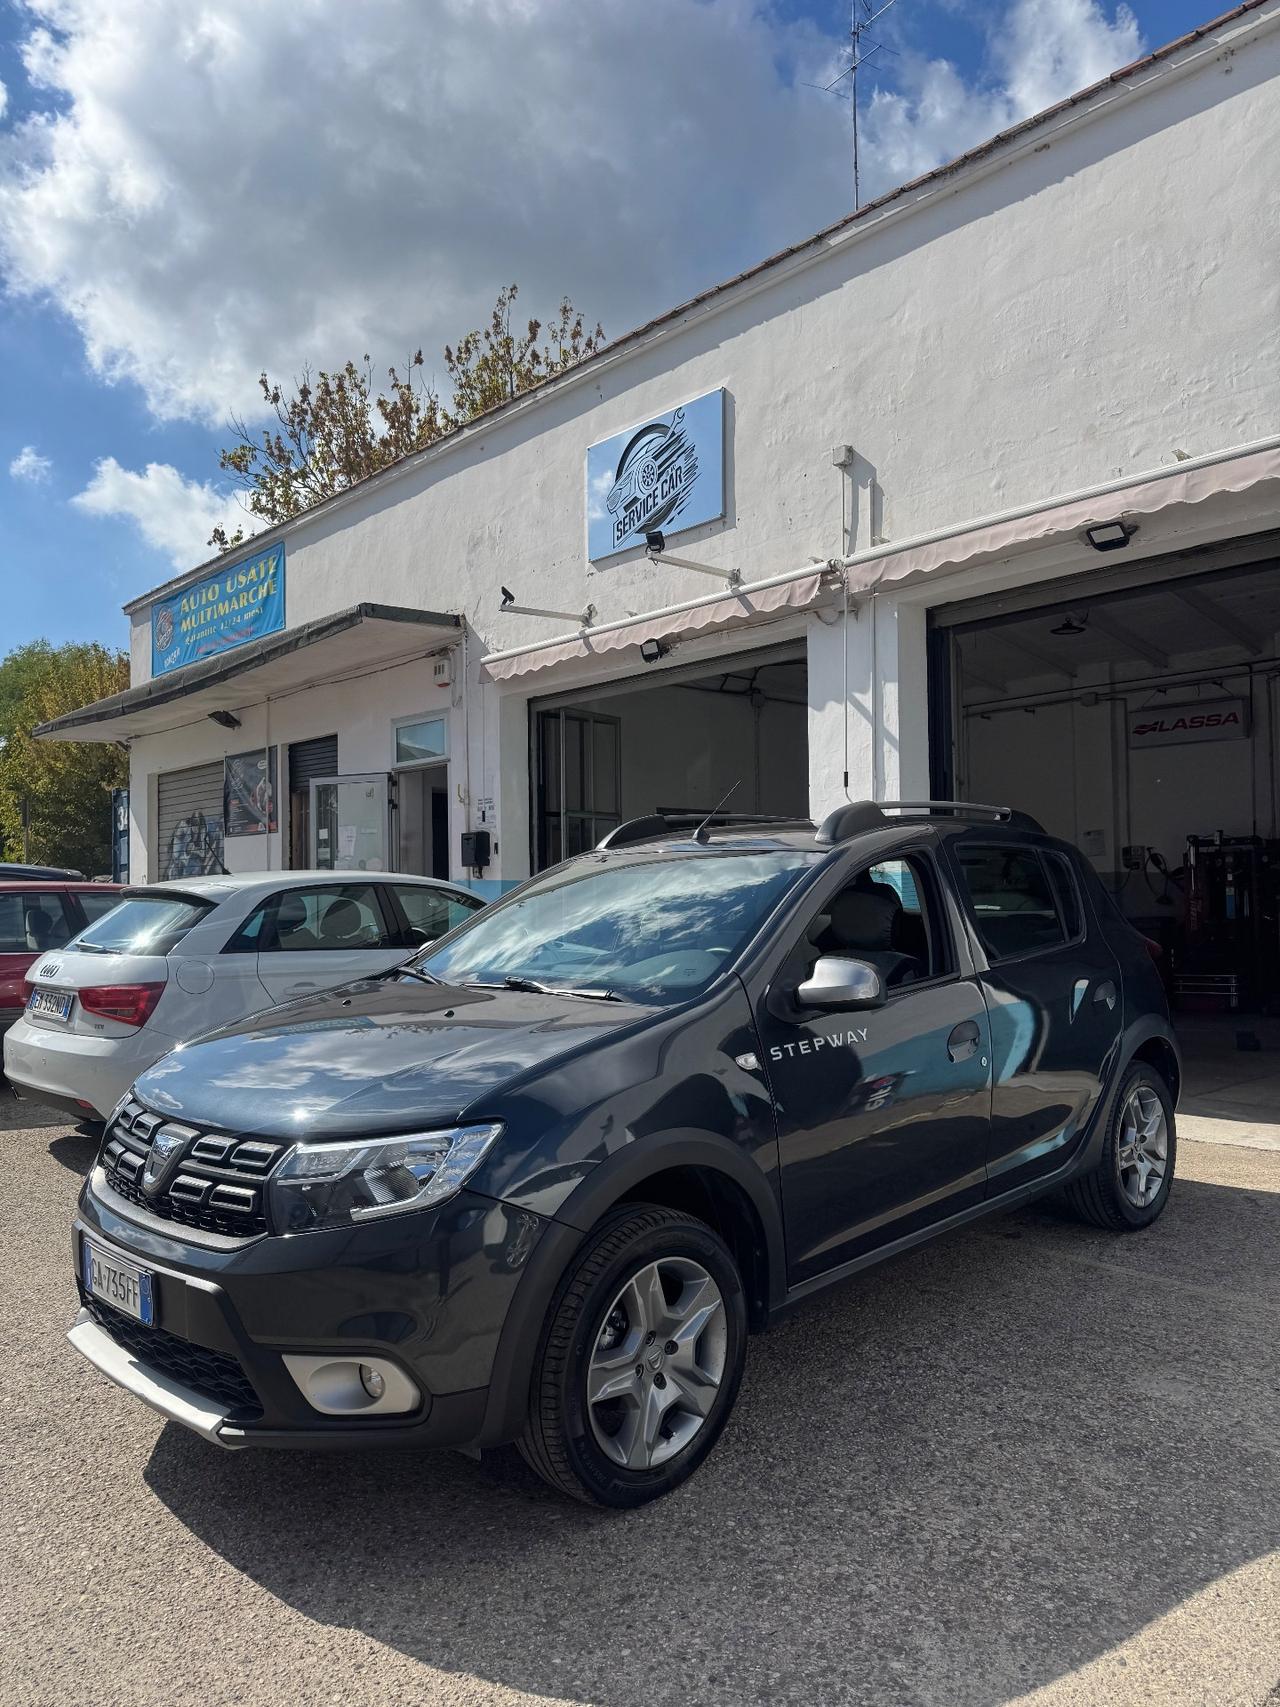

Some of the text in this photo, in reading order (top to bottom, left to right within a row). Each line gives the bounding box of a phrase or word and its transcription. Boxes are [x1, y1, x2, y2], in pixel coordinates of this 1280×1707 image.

[616, 465, 683, 541] SERVICE CAR
[180, 578, 278, 632] MULTIMARCHE
[181, 555, 277, 614] AUTO USATE
[1157, 711, 1240, 733] LASSA
[769, 1028, 868, 1061] STEPWAY
